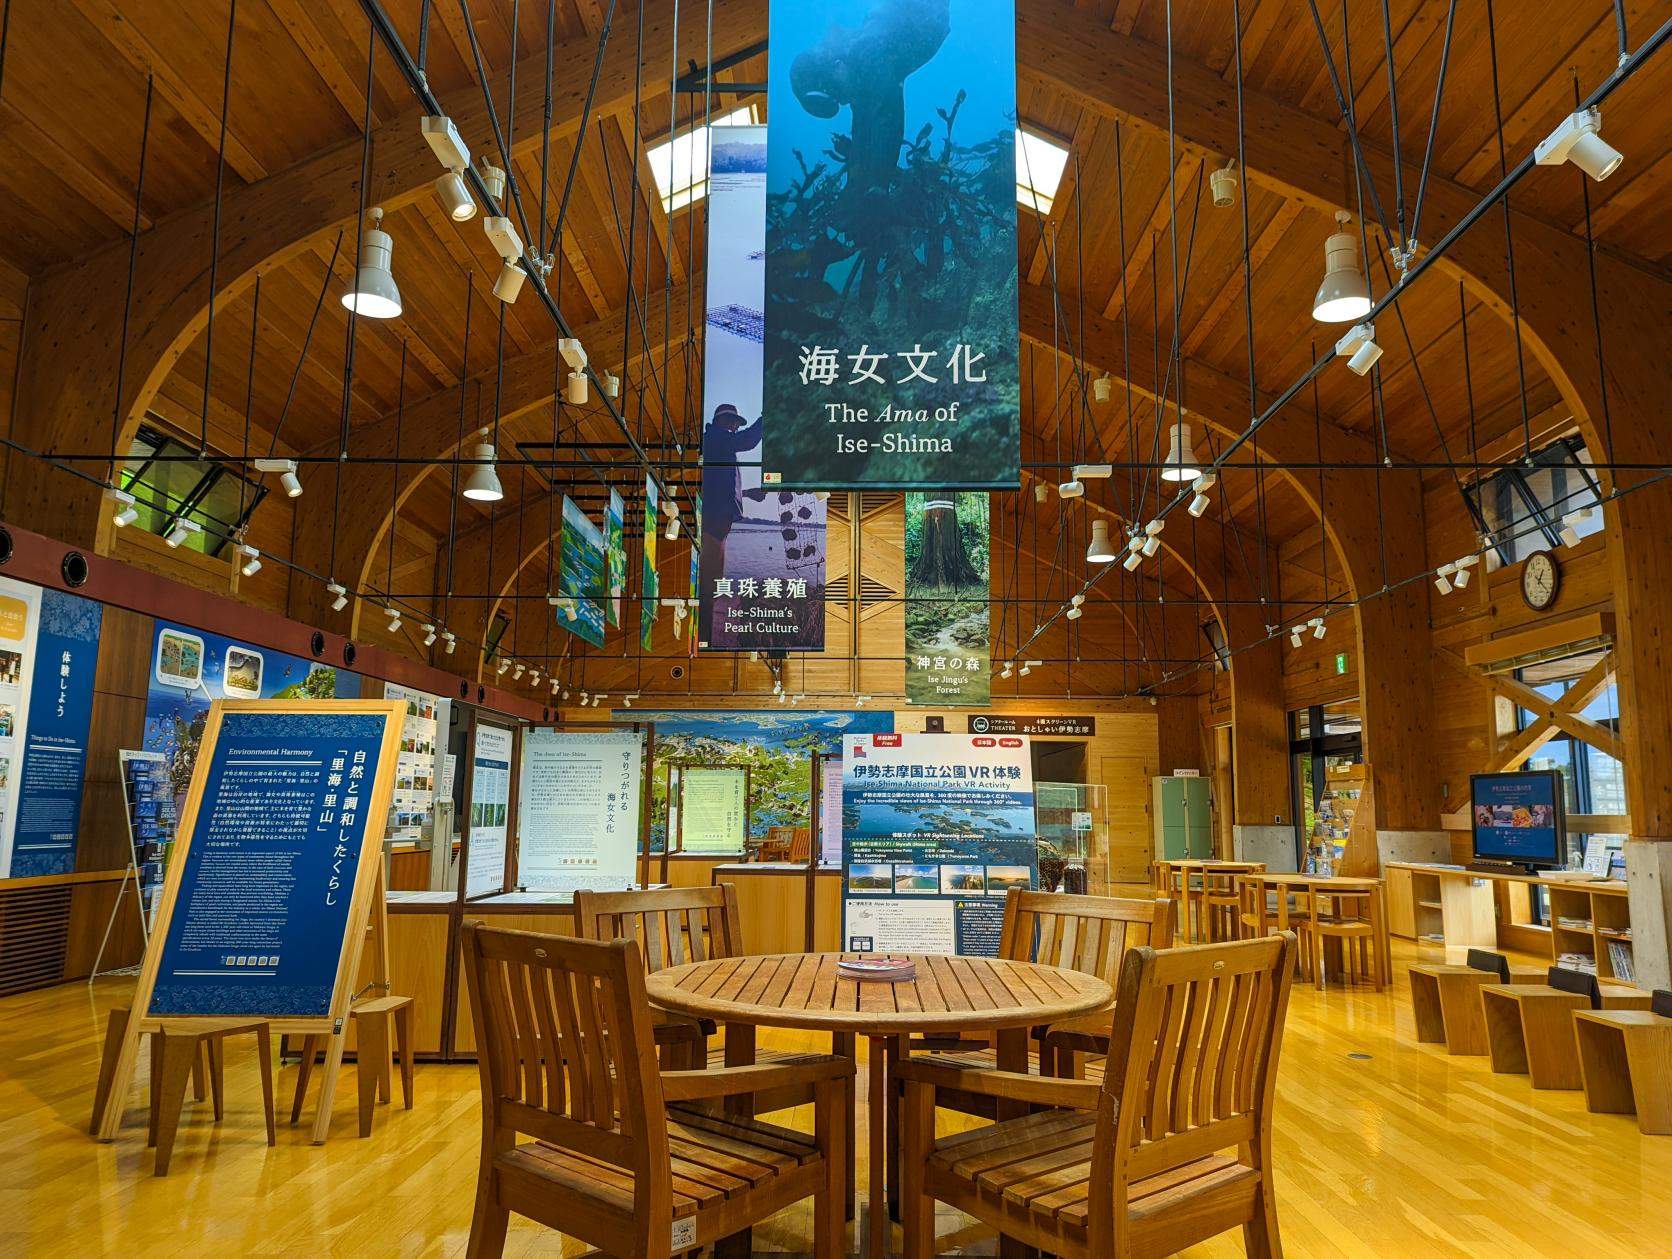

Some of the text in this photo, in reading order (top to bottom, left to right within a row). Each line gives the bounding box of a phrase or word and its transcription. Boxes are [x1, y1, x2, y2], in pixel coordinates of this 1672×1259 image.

[798, 344, 988, 386] 海女文化
[825, 401, 960, 423] The Ama of
[836, 433, 953, 454] Ise-Shima
[713, 577, 808, 600] 真珠養殖
[727, 606, 793, 618] Ise-Shima's
[724, 621, 799, 634] Pearl Culture
[916, 656, 980, 672] 神宮の森
[56, 650, 72, 718] 体験しよう
[928, 674, 969, 686] Ise Jingu's
[936, 686, 960, 695] Forest
[281, 749, 313, 757] Harmony
[316, 749, 348, 833] 「里海・里山」
[620, 752, 632, 811] 守りつがれる
[979, 782, 1010, 790] Activity
[606, 793, 616, 834] 海女文化
[325, 750, 366, 906] 自然と調和したくらし
